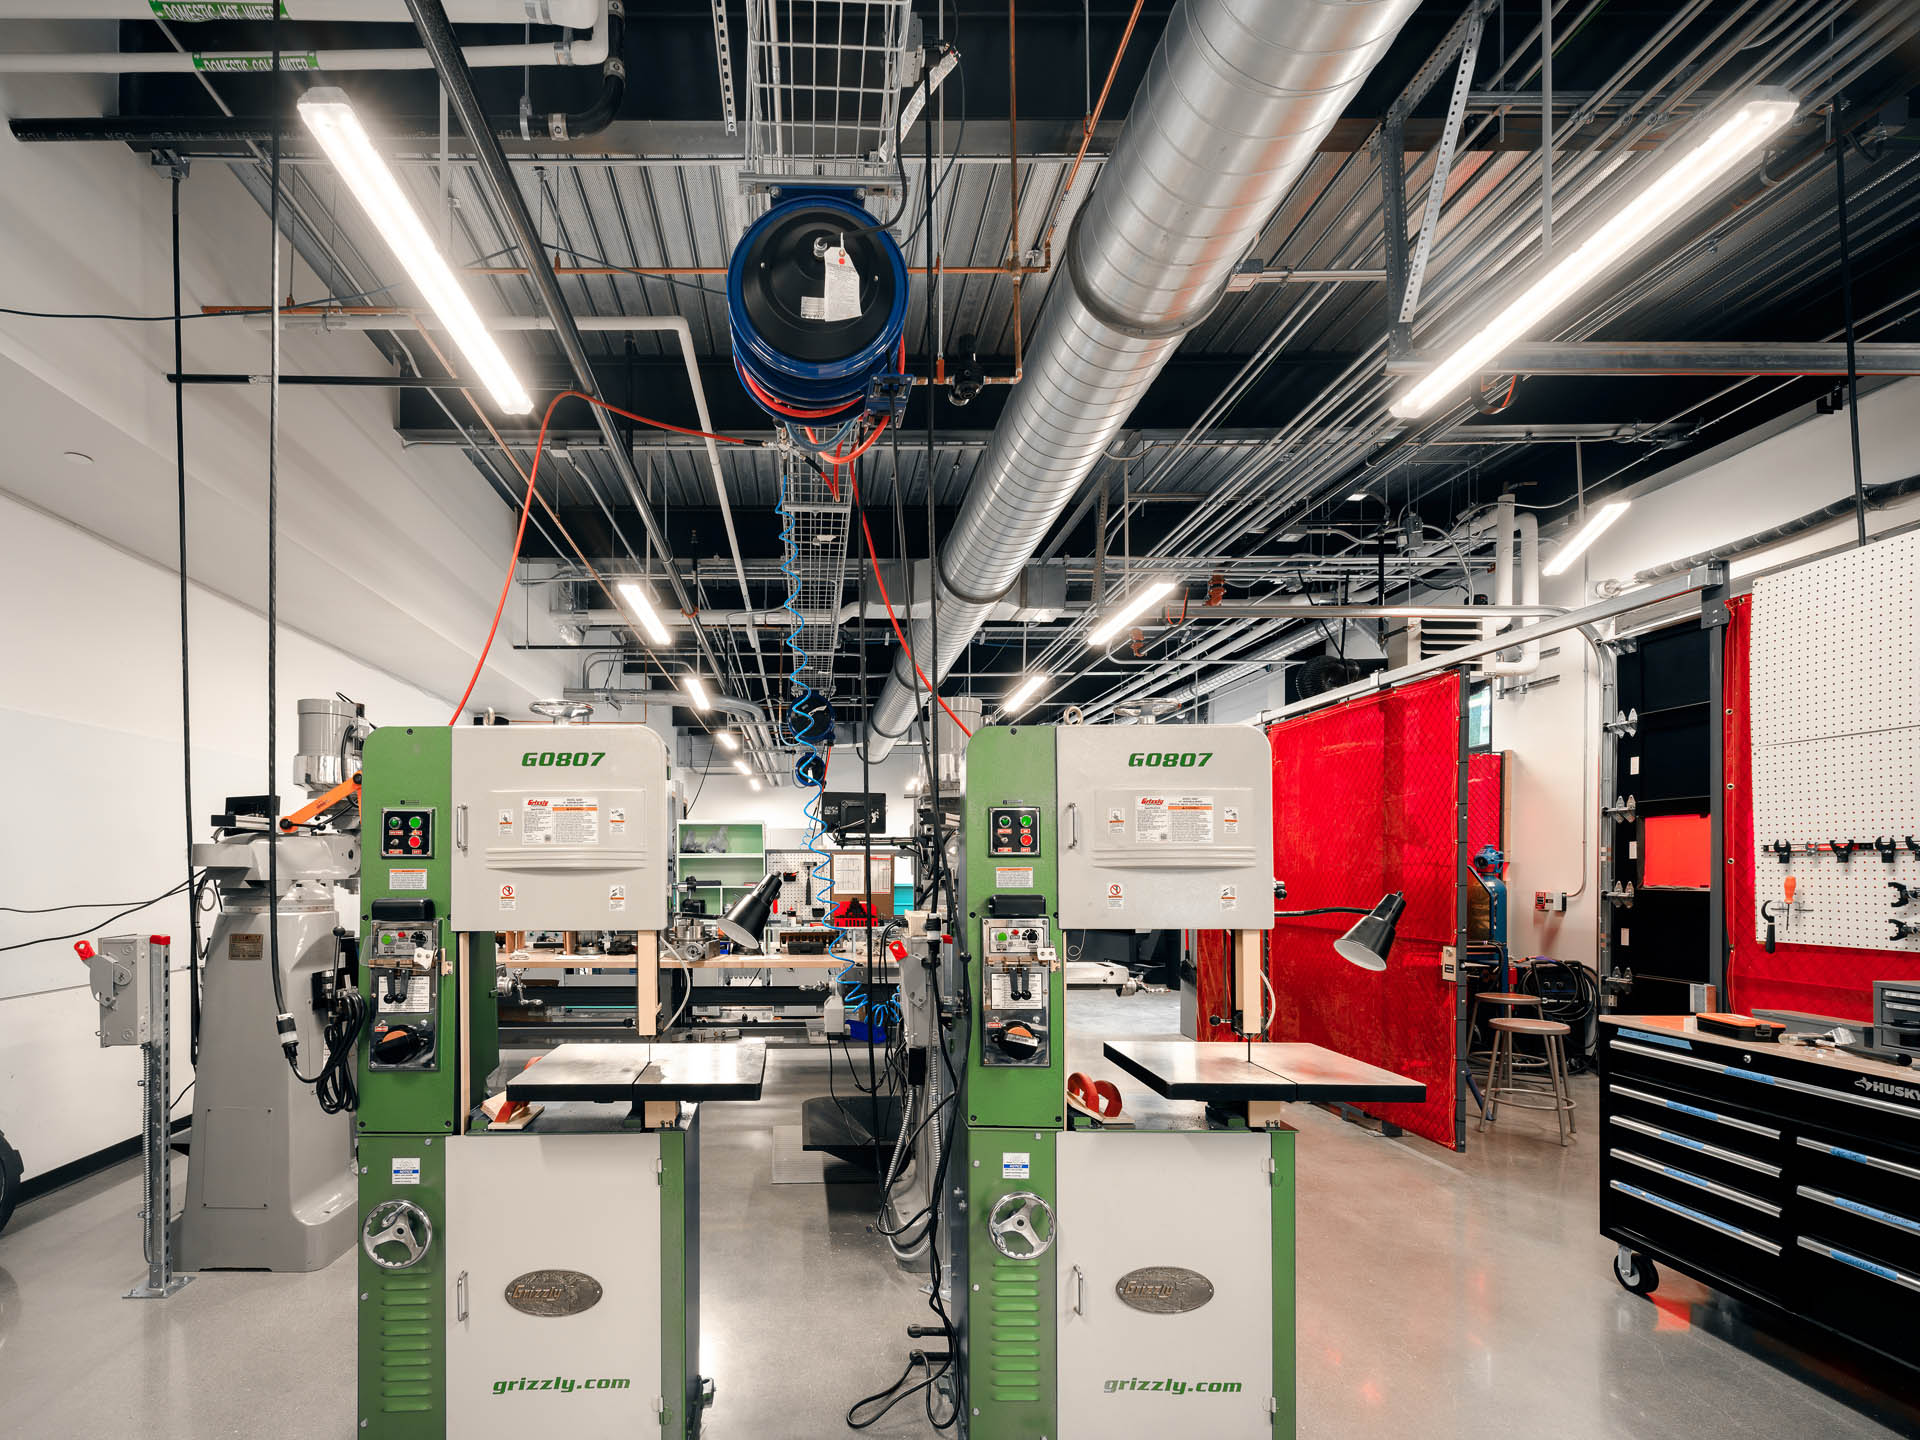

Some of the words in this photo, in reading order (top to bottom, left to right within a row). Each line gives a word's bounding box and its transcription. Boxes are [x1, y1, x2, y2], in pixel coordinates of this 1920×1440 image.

[162, 4, 217, 21] DOMESTIC
[217, 4, 241, 20] HOT
[203, 59, 248, 72] DOMESTIC
[252, 58, 273, 72] COL
[512, 1284, 563, 1301] Grizzly
[1125, 1280, 1174, 1298] Grizzly
[492, 1376, 630, 1395] grizzly.com
[1104, 1377, 1242, 1395] grizzly.com
